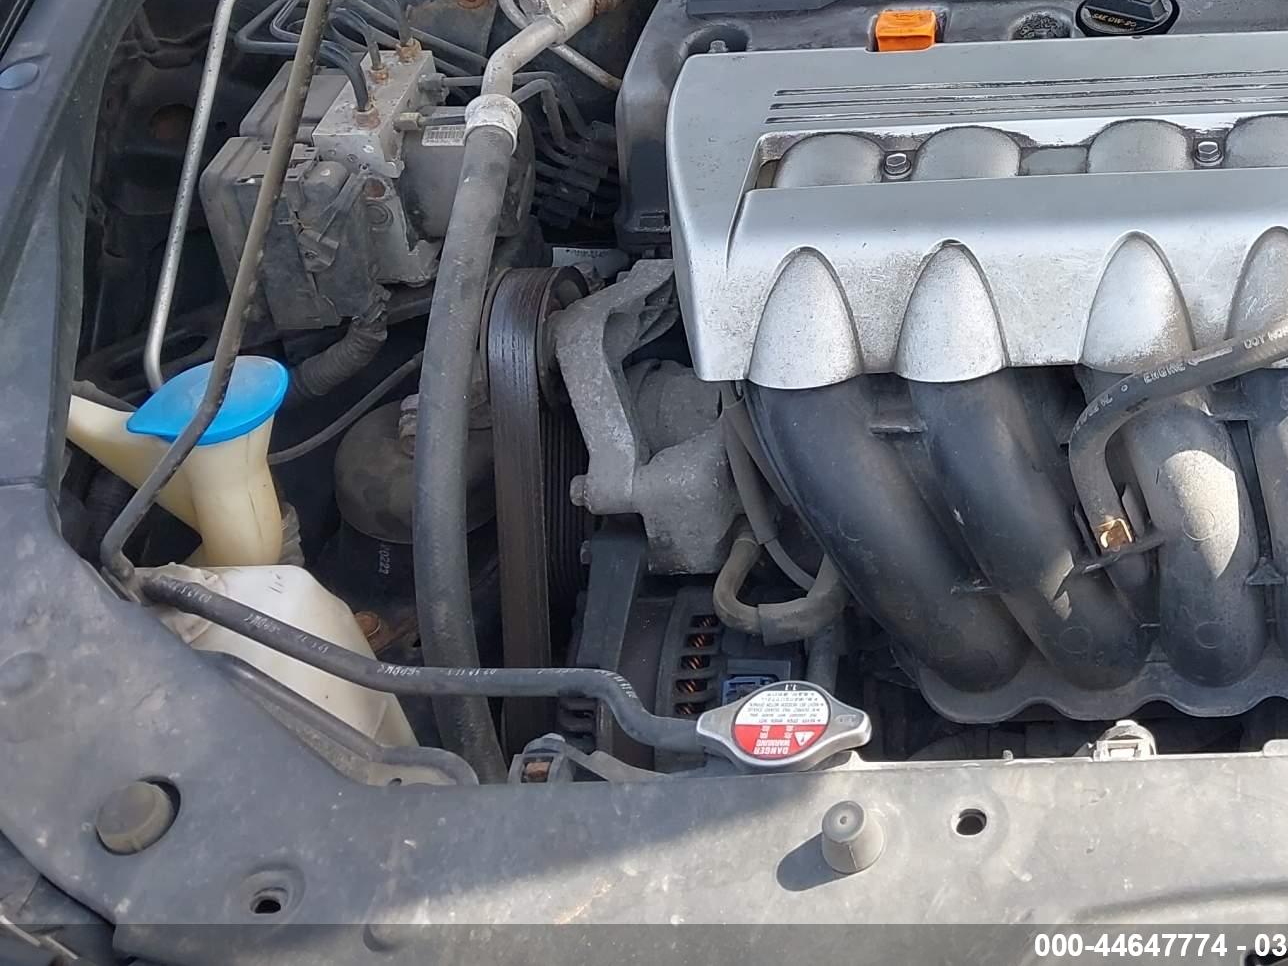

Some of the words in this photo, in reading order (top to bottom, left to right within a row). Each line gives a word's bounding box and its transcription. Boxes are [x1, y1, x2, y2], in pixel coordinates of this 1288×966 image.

[1143, 362, 1186, 384] ENGINE
[756, 739, 791, 747] WARNING
[753, 746, 790, 755] DANGER
